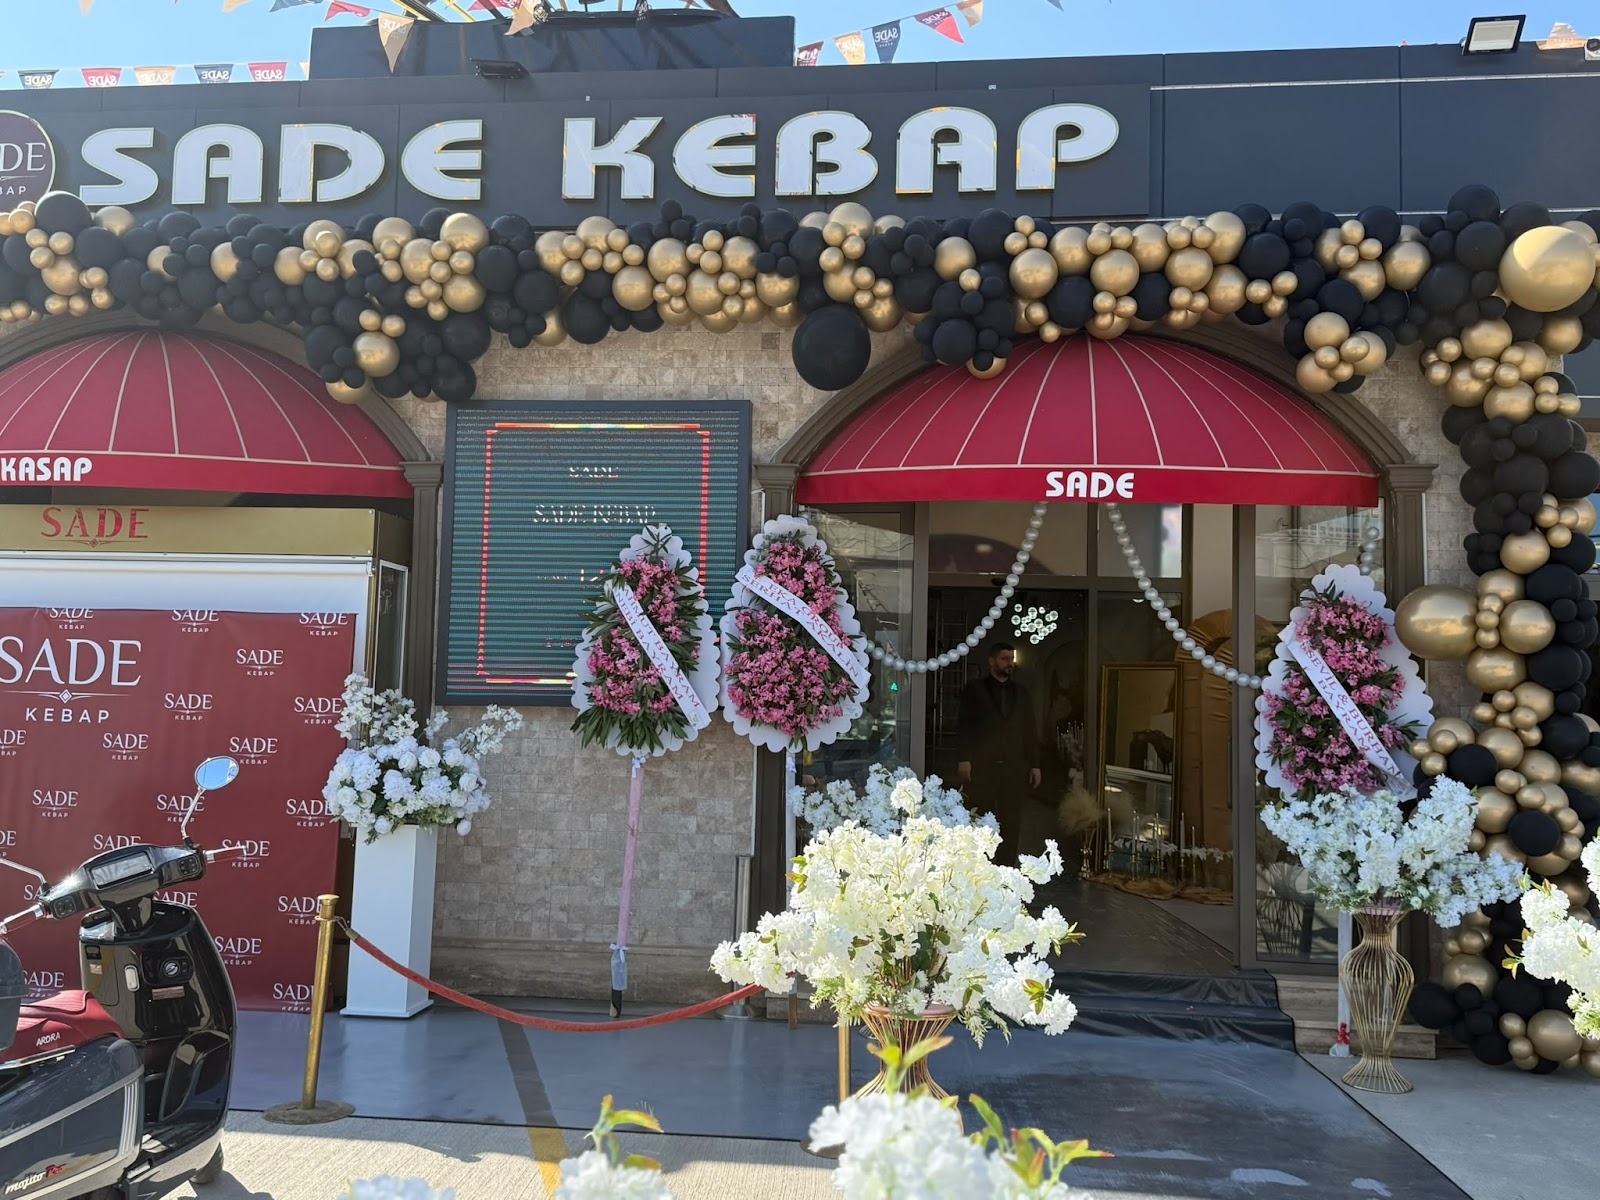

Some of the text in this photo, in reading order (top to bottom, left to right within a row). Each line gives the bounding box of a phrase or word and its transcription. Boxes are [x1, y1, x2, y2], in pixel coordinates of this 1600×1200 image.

[0, 143, 46, 171] DE
[79, 102, 1120, 207] SADE KEBAP
[0, 456, 93, 482] KASAP
[1046, 471, 1135, 499] SADE
[41, 506, 149, 539] SADE
[742, 574, 805, 615] SERHAT
[0, 636, 142, 686] SADE
[236, 648, 283, 665] SADE
[636, 628, 684, 700] BAYRAM
[655, 640, 701, 708] BAYRAM
[164, 692, 213, 710] SADE
[294, 696, 343, 713] SADE
[25, 707, 110, 724] KEBAP
[1317, 678, 1370, 753] BAYRAM
[102, 732, 149, 750] SADE
[229, 736, 278, 754] SADE
[1349, 707, 1401, 774] BURHAN
[32, 789, 79, 807] SADE
[214, 935, 262, 954] SADE
[36, 1031, 61, 1047] ARORA
